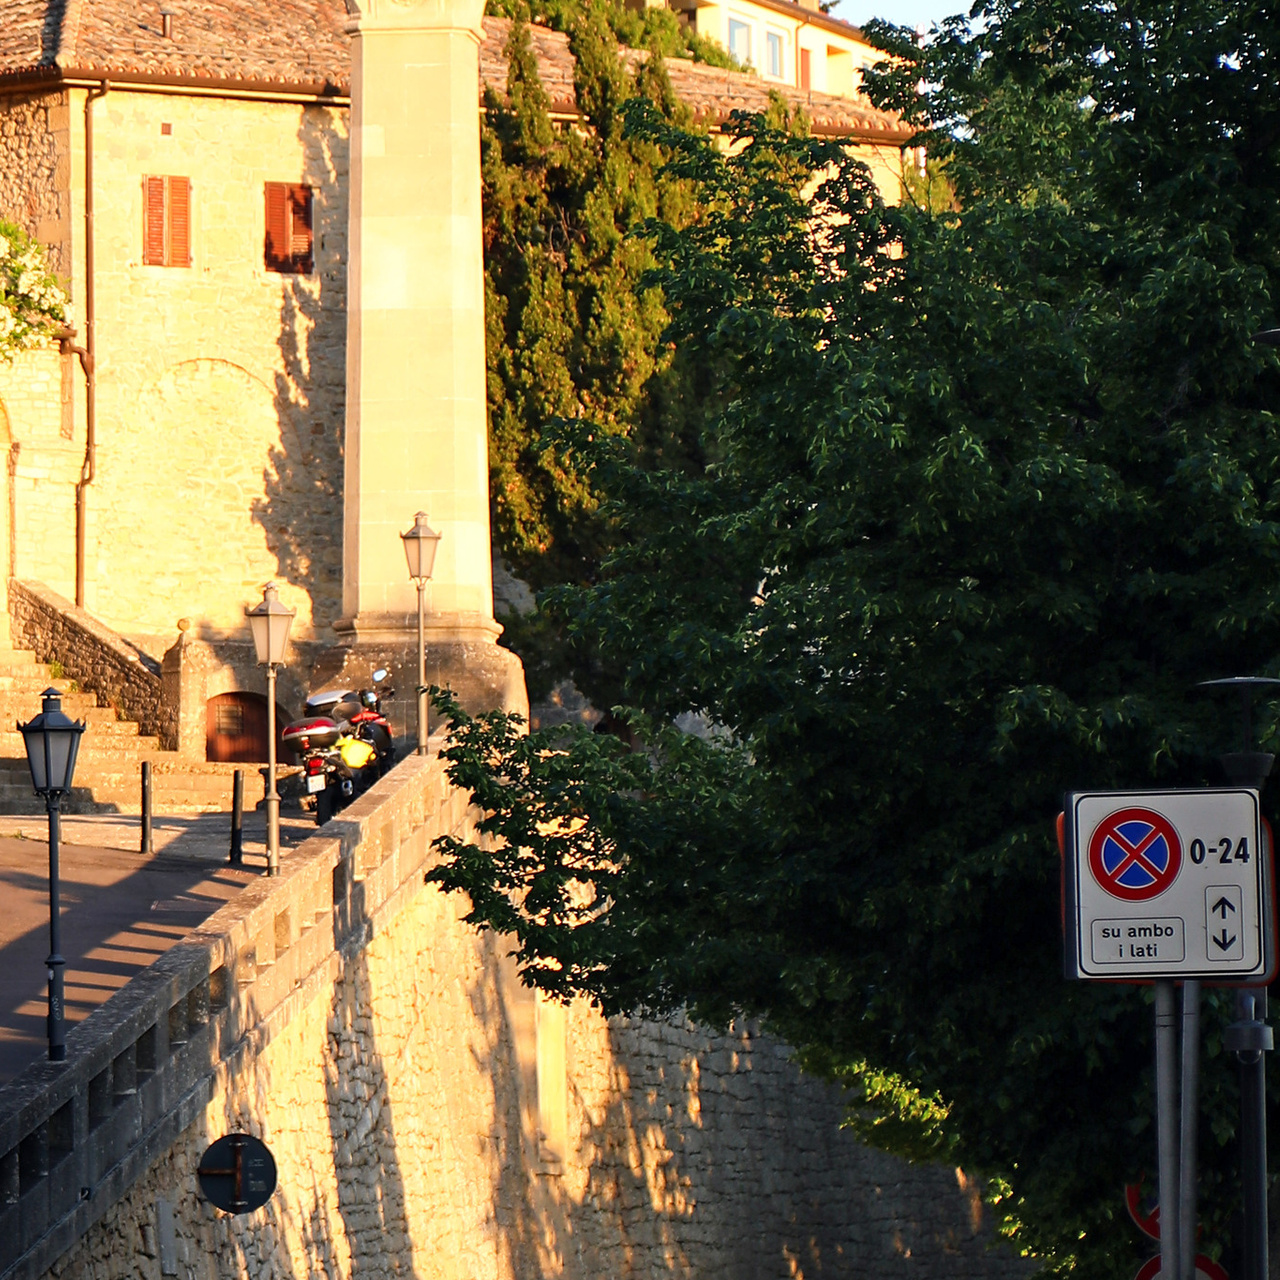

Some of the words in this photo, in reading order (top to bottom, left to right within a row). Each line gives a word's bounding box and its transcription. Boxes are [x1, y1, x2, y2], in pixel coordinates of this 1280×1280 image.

[1190, 837, 1250, 864] 0-24
[1102, 927, 1121, 938] su
[1127, 923, 1174, 938] ambo
[1119, 944, 1123, 958] i
[1130, 943, 1158, 958] lati
